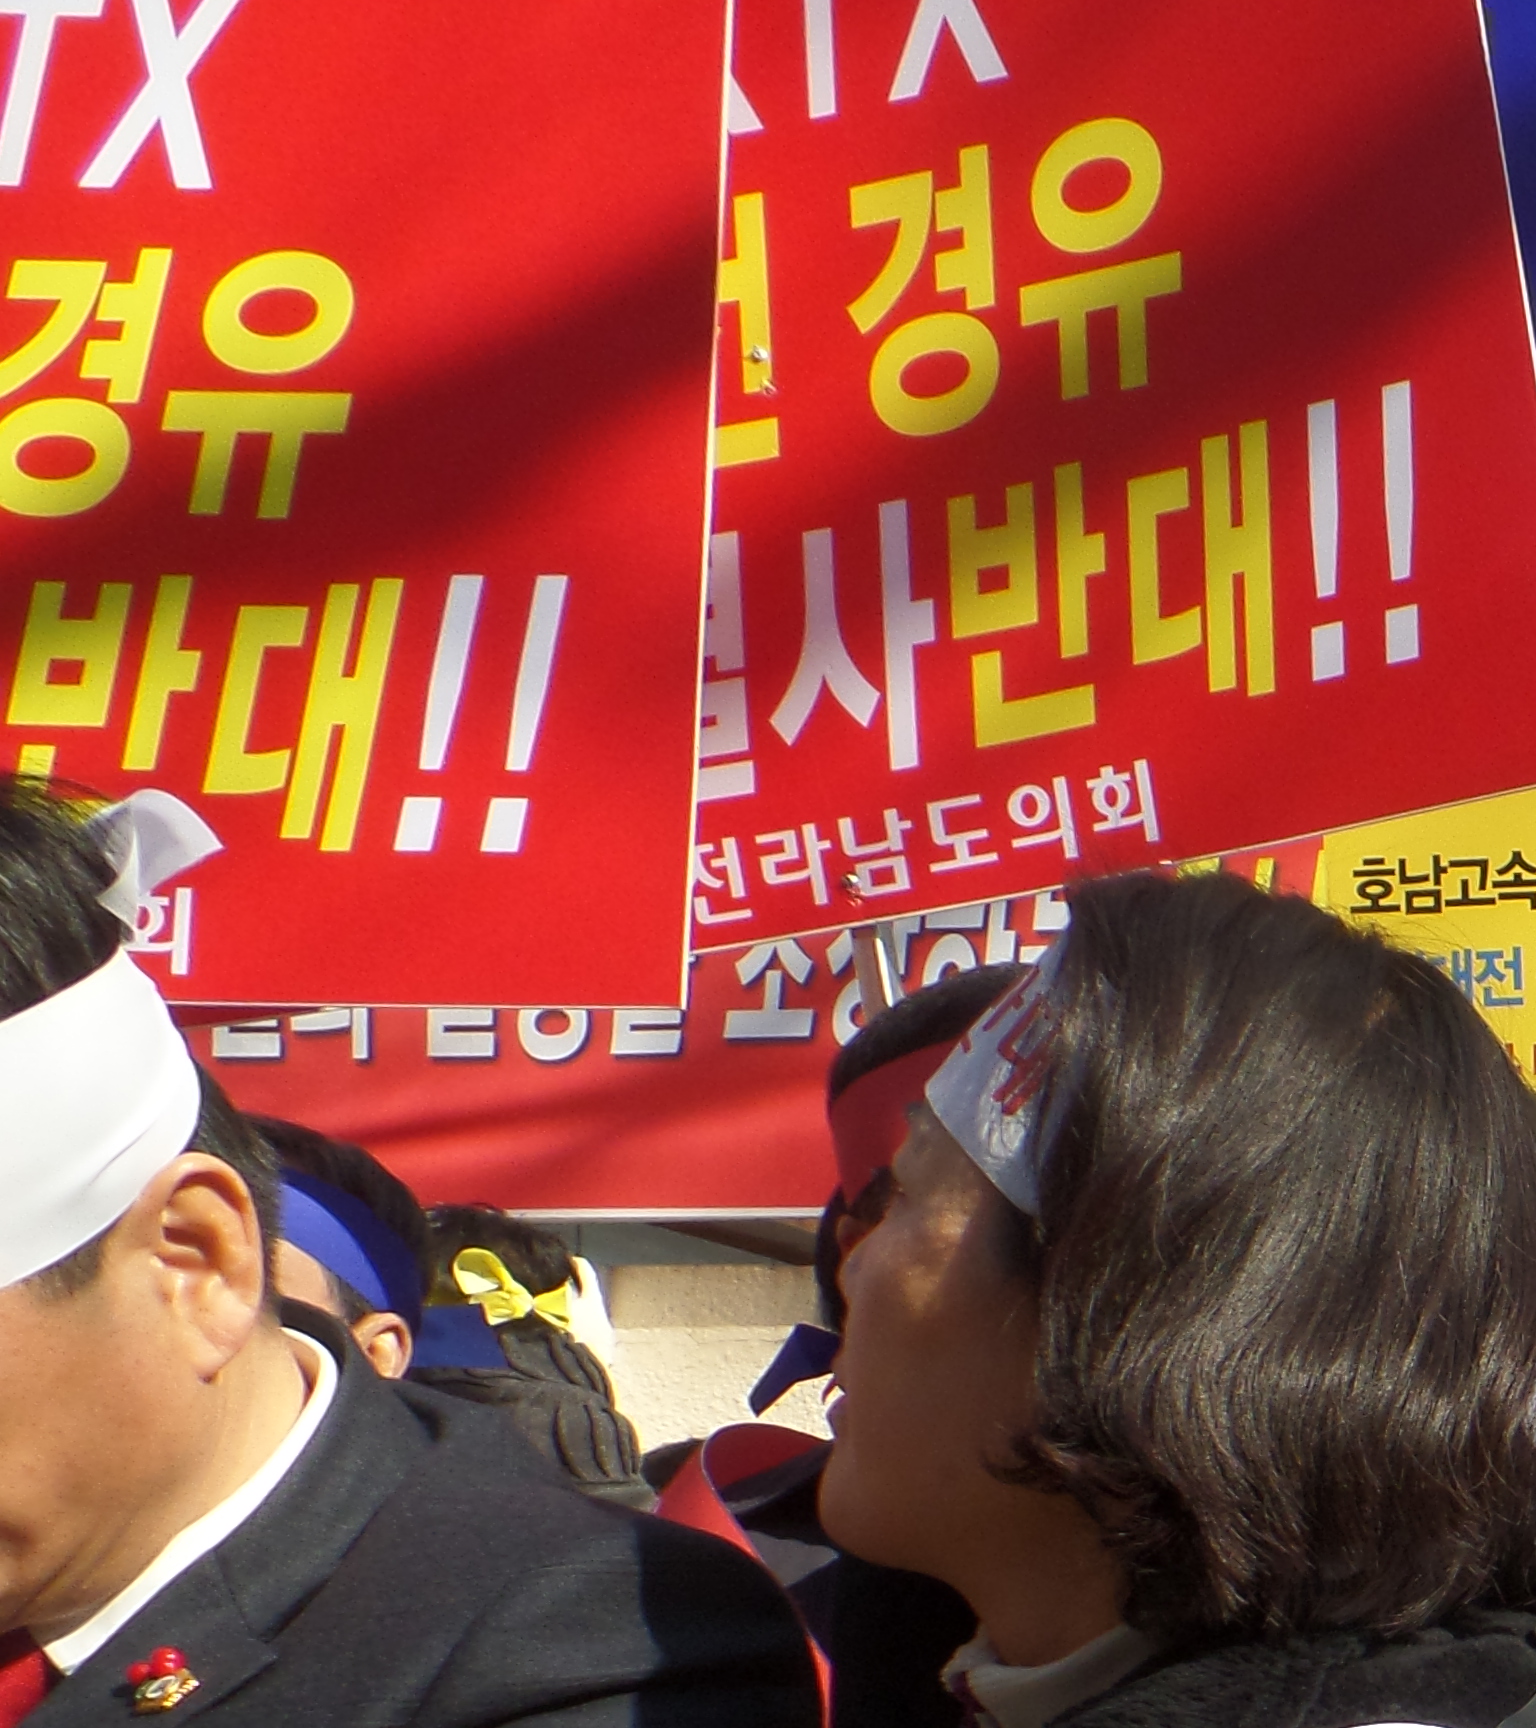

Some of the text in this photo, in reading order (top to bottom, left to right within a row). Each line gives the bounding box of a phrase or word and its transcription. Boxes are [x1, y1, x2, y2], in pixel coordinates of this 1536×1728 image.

[0, 248, 354, 519] 경유
[847, 117, 1182, 436] 경유
[6, 574, 567, 852] 반대!!
[694, 759, 1160, 926] 전라남도의회
